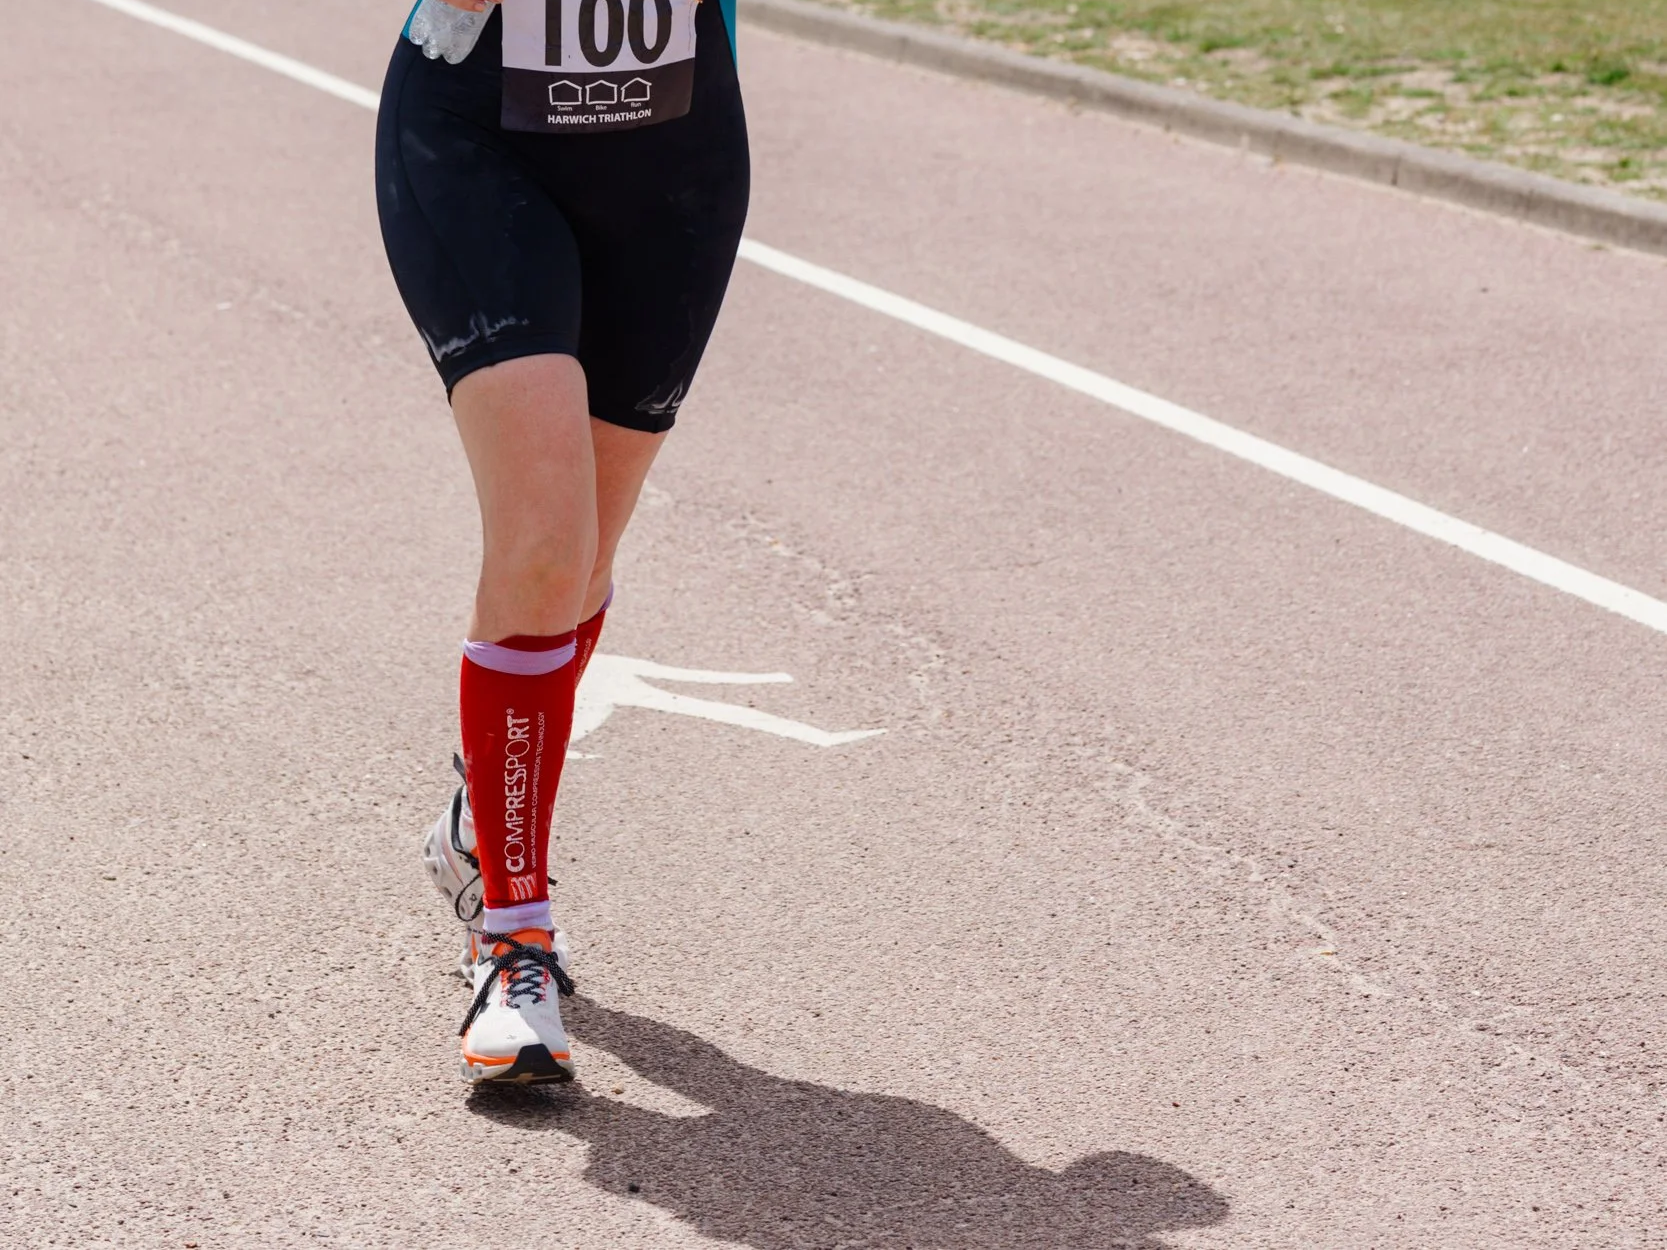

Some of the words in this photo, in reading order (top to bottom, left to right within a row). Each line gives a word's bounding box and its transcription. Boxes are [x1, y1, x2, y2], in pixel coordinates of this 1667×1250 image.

[547, 114, 597, 124] HARWICH
[598, 108, 652, 123] TRIATHLON
[535, 711, 545, 755] TECHNOLOGY
[531, 755, 542, 806] COMPRESSION
